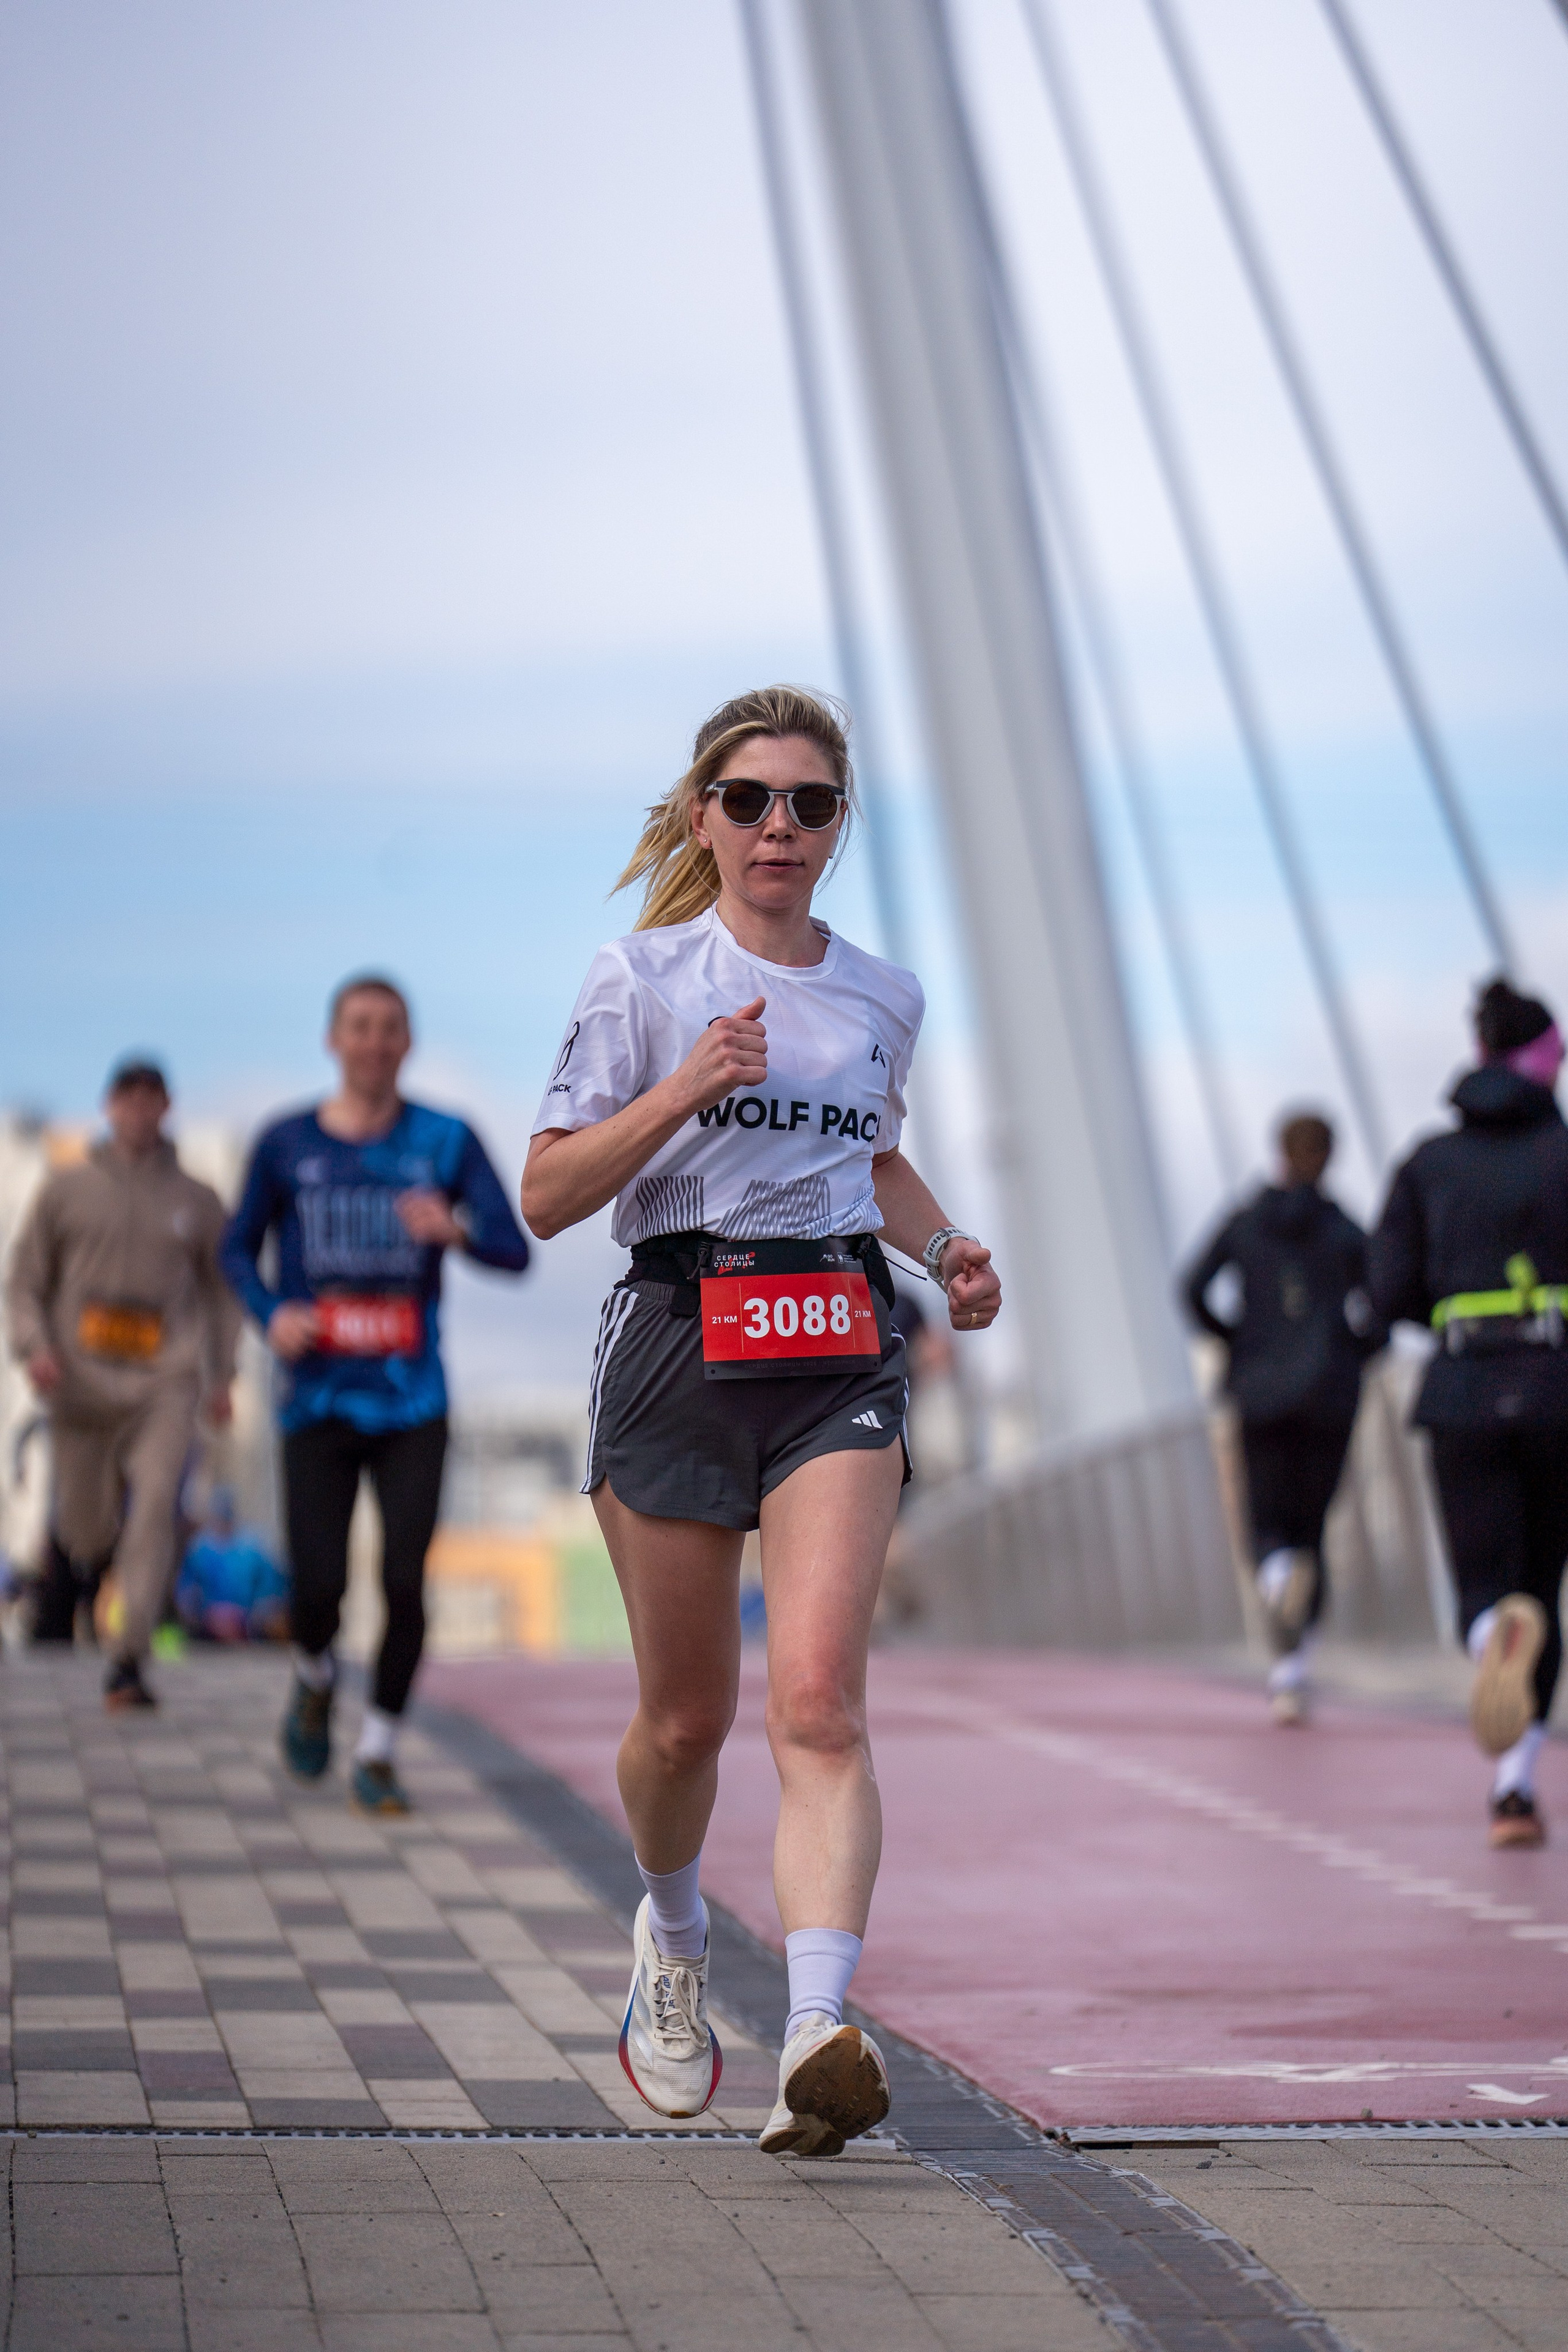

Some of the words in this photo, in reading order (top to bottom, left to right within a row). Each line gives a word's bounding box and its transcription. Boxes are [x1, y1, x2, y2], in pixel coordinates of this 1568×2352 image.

[697, 1096, 809, 1131] WOLF
[820, 1104, 881, 1143] PAC
[743, 1294, 851, 1338] 3088
